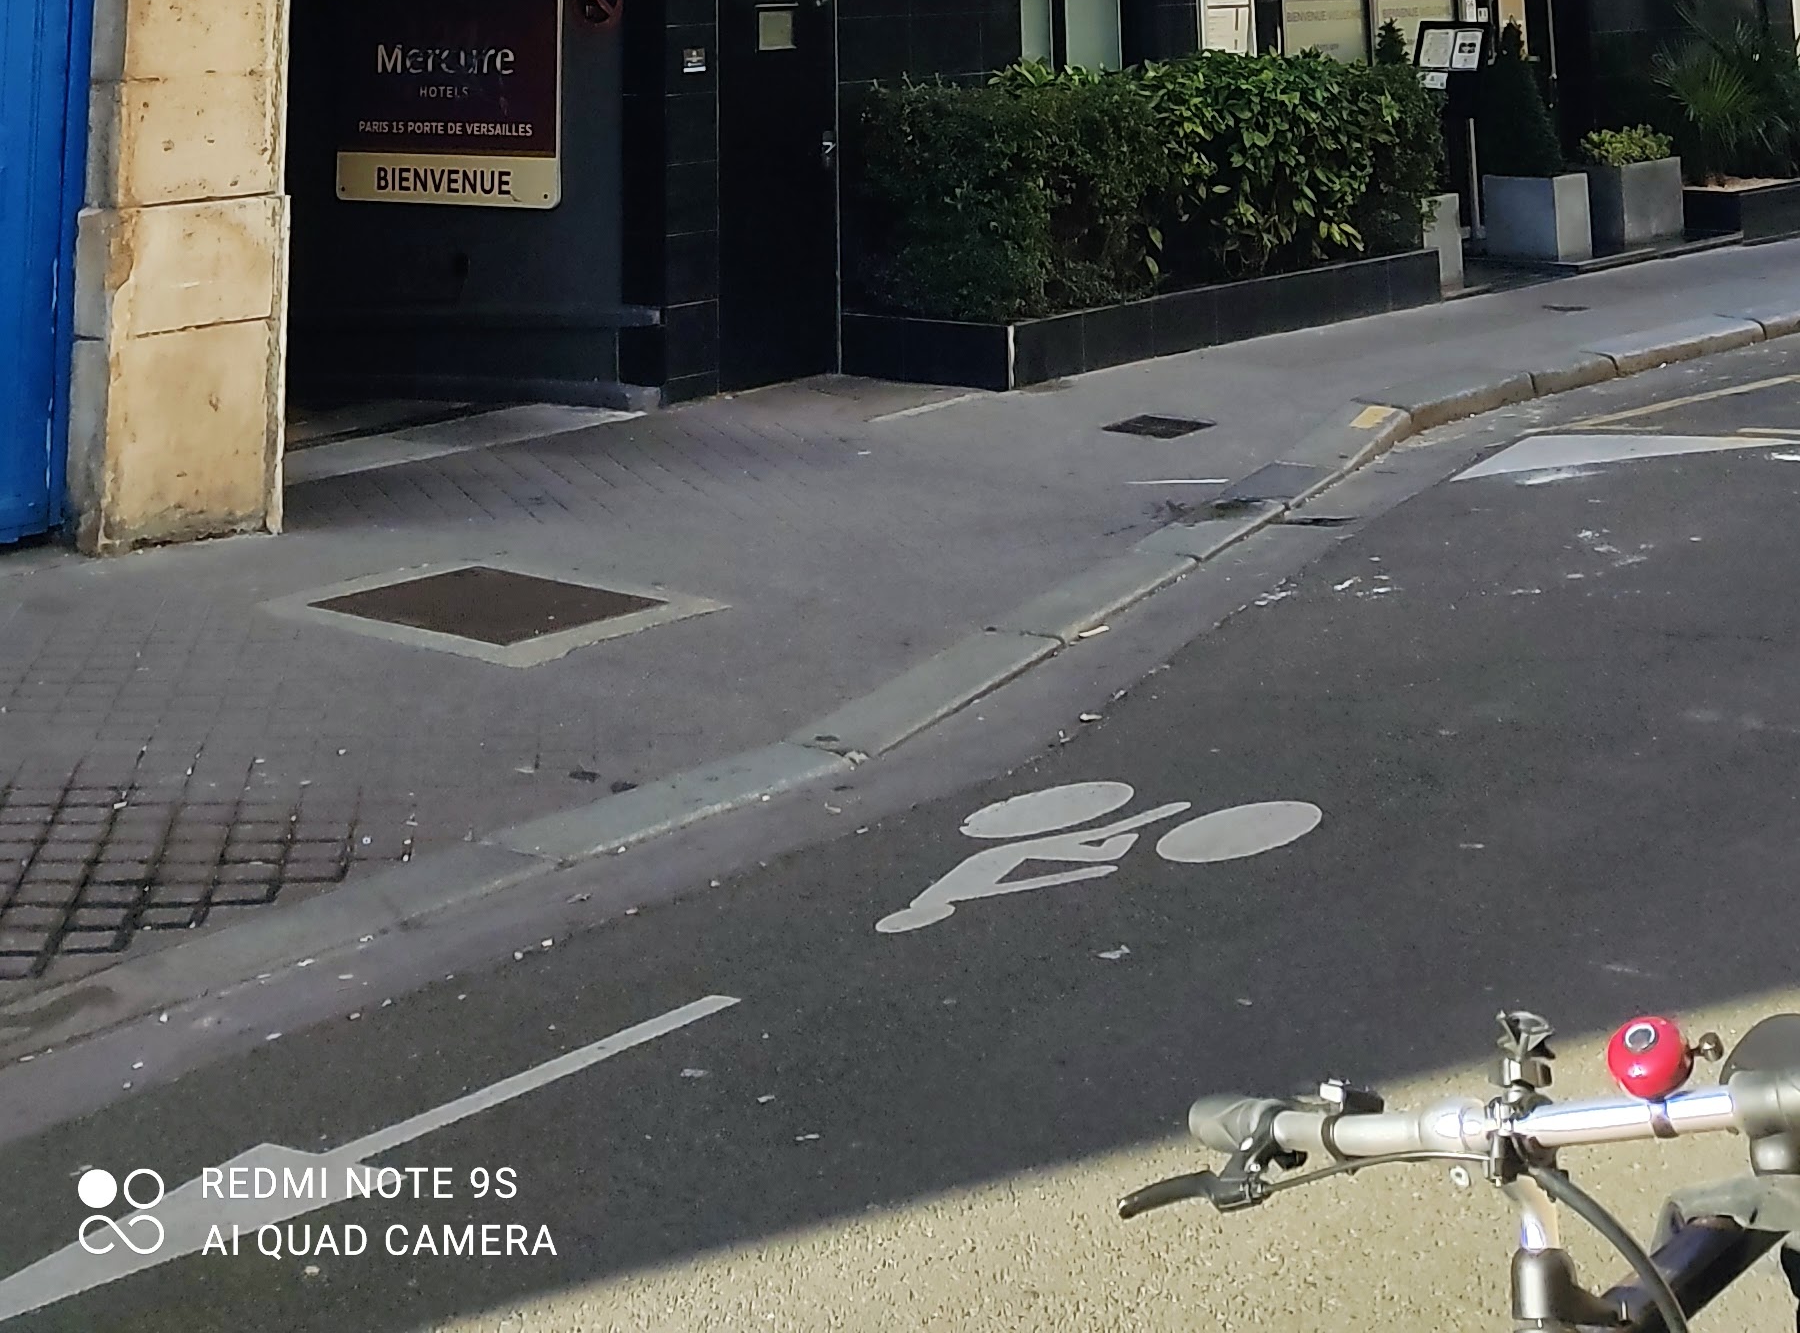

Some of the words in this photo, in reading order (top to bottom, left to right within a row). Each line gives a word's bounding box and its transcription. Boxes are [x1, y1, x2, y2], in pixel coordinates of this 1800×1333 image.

[377, 43, 516, 75] Mercure
[419, 86, 469, 99] HOTELS
[358, 121, 389, 134] PARIS
[391, 121, 405, 134] 15
[407, 122, 445, 135] PORTE
[447, 123, 463, 135] DE
[466, 123, 533, 137] VERSAILLES
[376, 166, 513, 196] BIENVENUE
